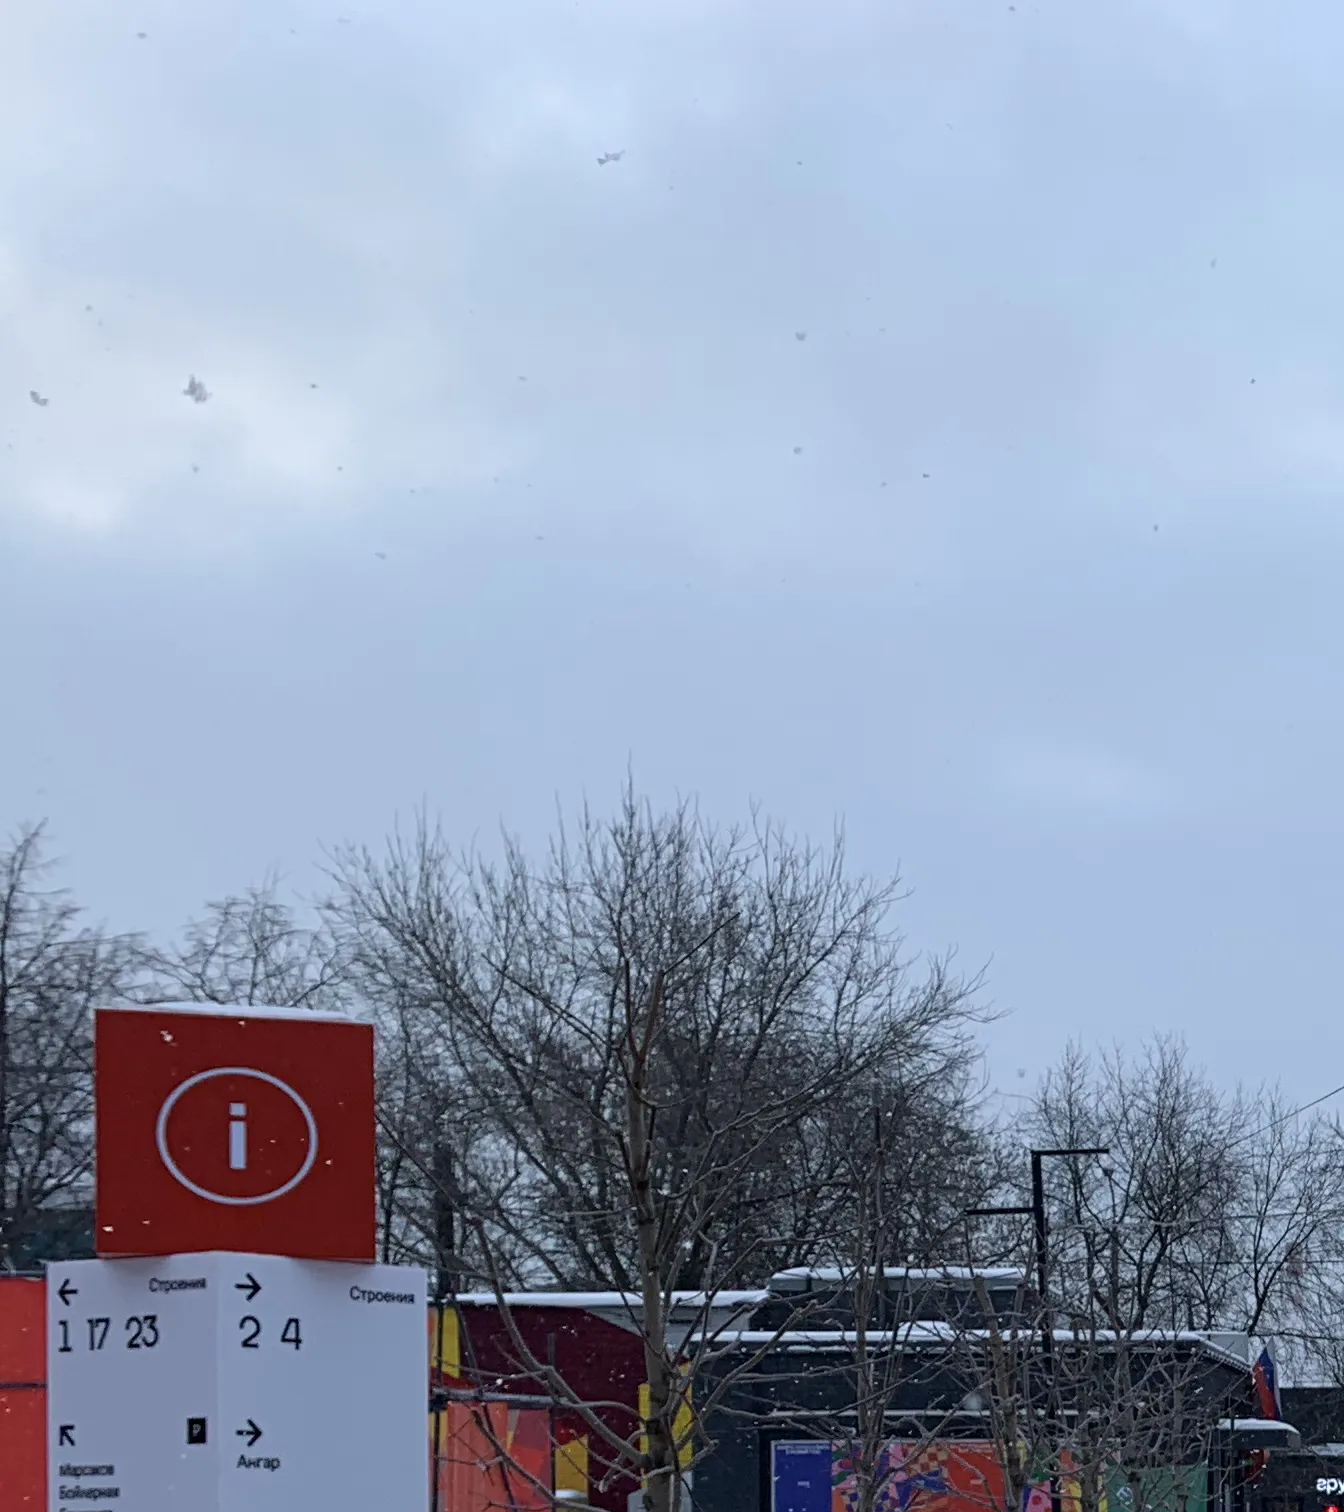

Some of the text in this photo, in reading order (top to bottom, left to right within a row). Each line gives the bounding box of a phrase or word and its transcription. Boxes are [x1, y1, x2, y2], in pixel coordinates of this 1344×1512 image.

[149, 1276, 207, 1294] Строения
[350, 1285, 415, 1305] Строения
[58, 1314, 160, 1353] 1 17 23
[239, 1314, 303, 1351] 2 4
[236, 1455, 281, 1472] Ангар
